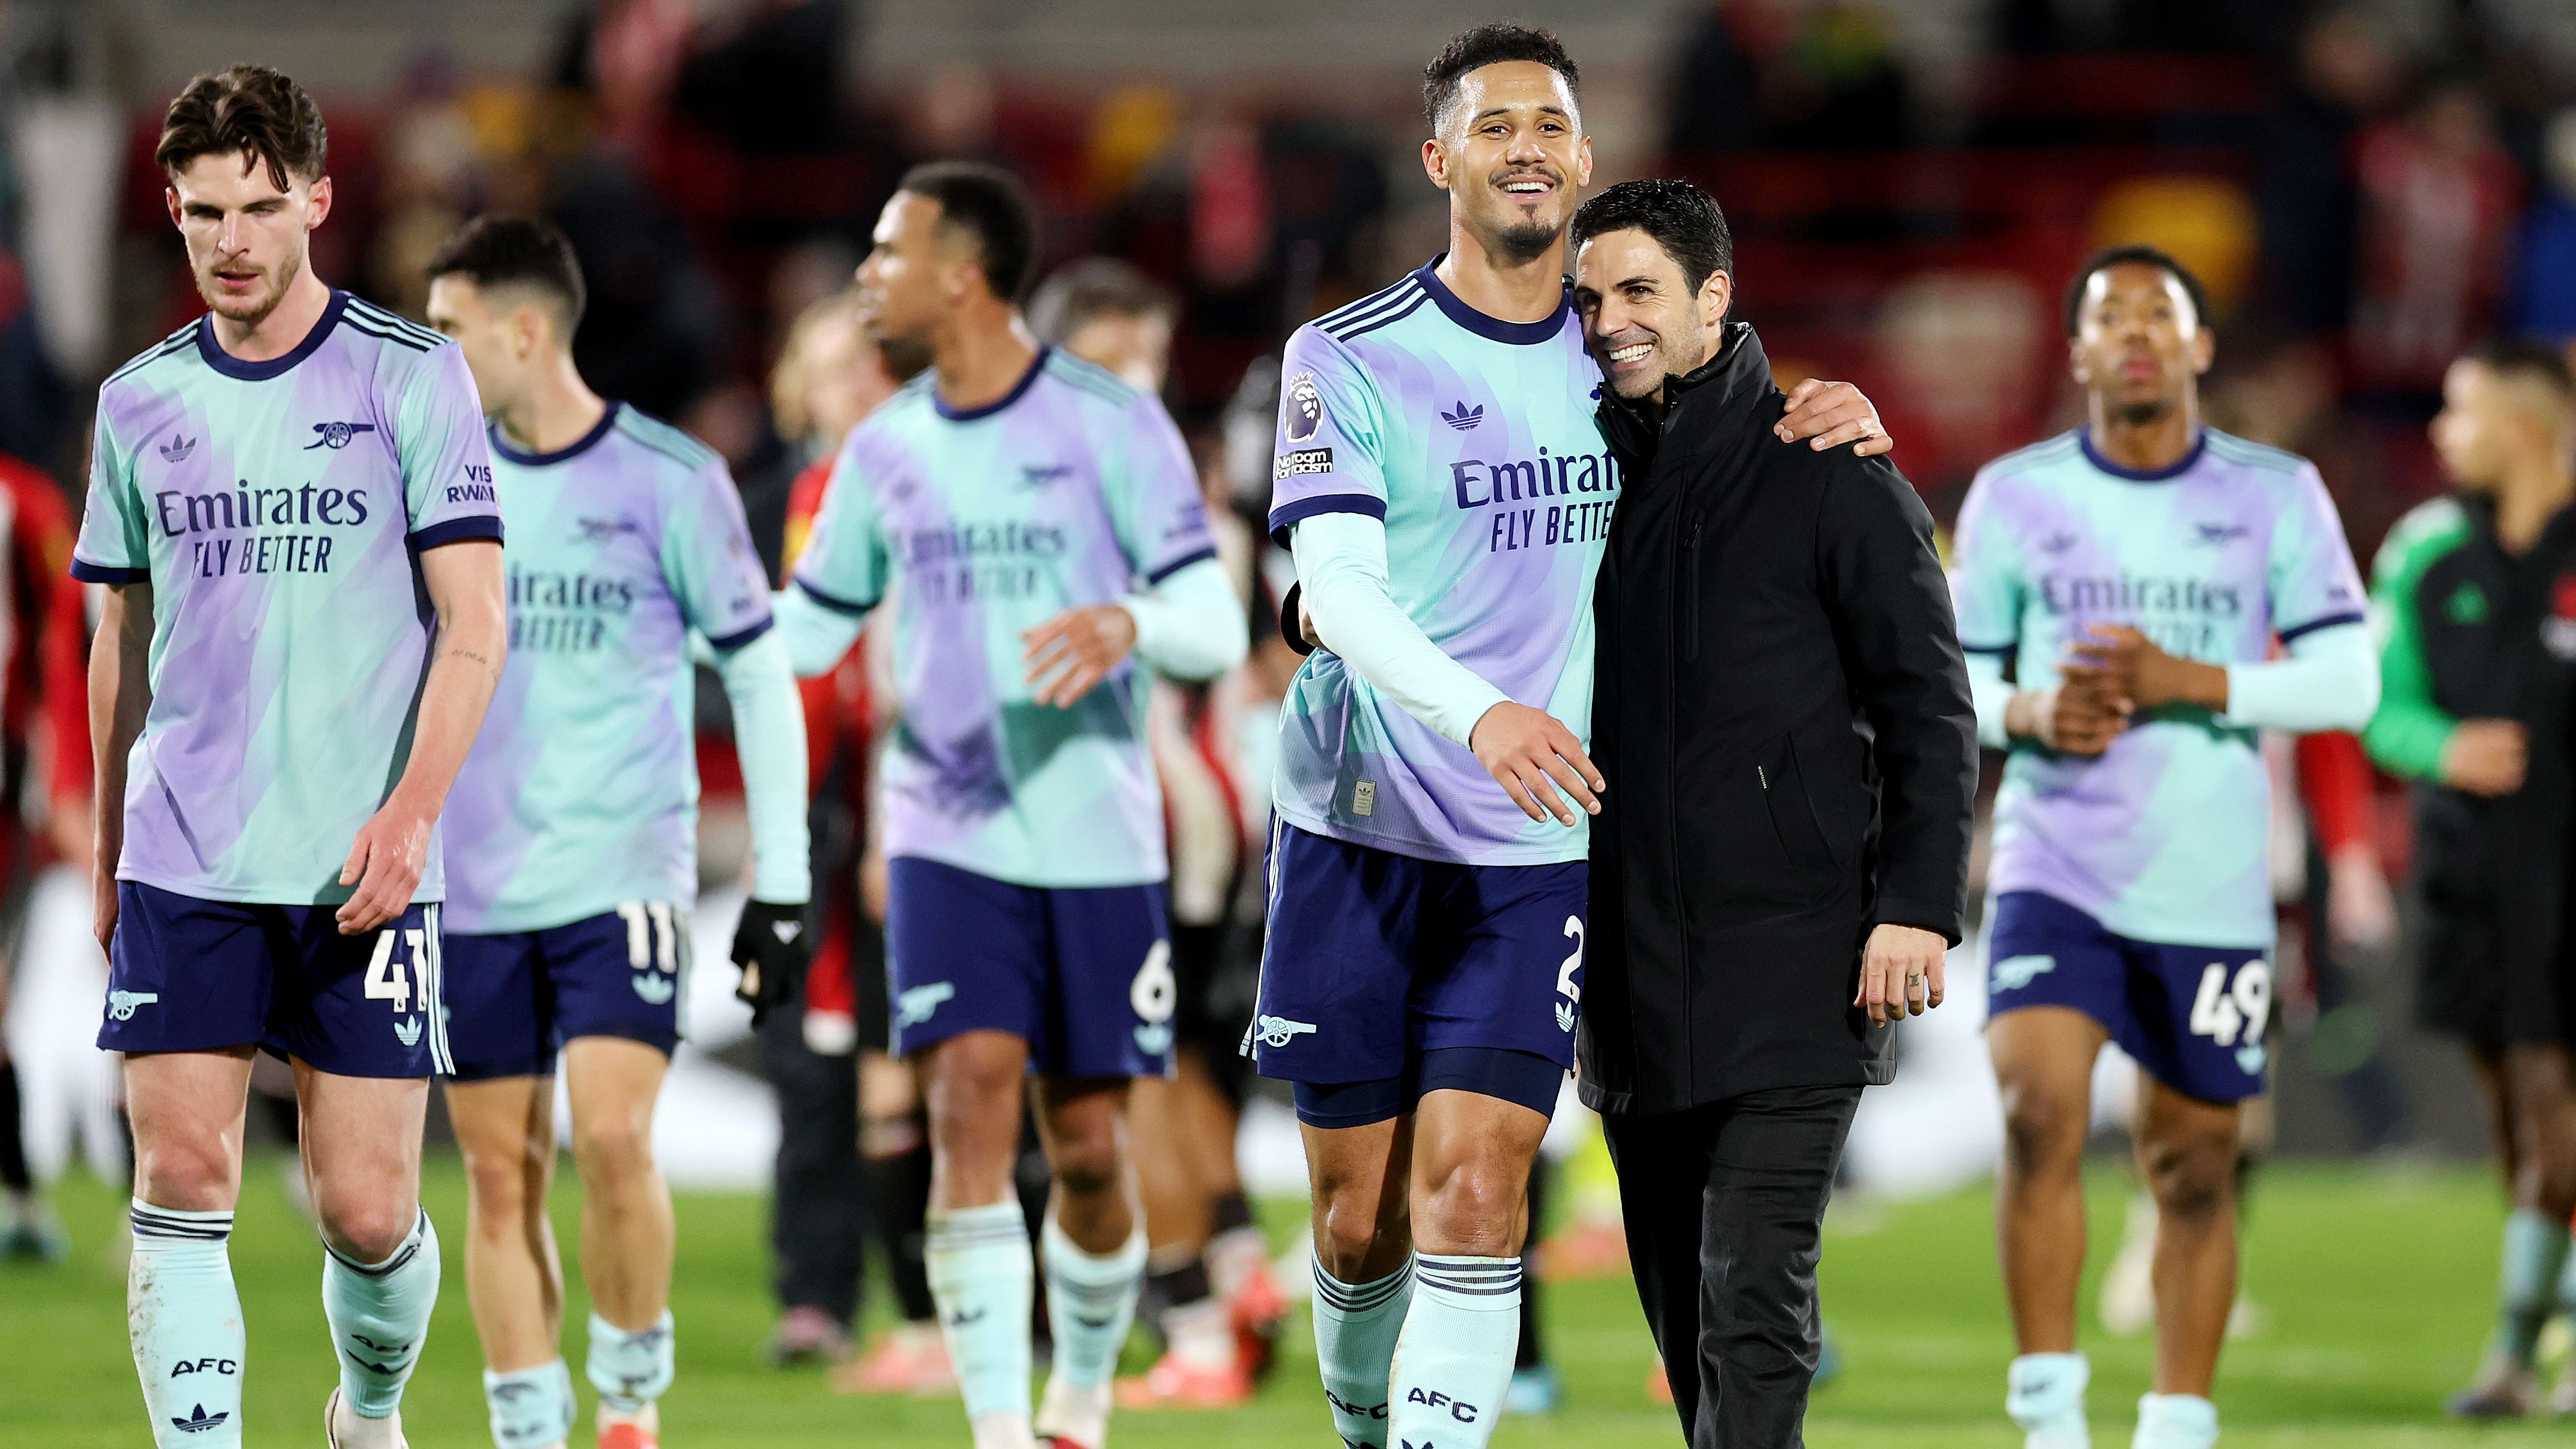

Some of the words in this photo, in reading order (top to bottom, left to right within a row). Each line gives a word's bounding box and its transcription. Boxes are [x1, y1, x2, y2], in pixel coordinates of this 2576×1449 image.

[464, 464, 491, 482] VIS
[1277, 457, 1291, 469] No
[1291, 451, 1326, 465] room
[1291, 461, 1333, 476] racism
[1449, 446, 1615, 509] Emirat
[155, 479, 368, 537] Emirates
[1490, 508, 1535, 552] FLY
[1545, 500, 1614, 546] BETTE
[192, 541, 232, 579] FLY
[239, 535, 332, 575] BETTER
[510, 560, 634, 615] irates
[616, 899, 678, 974] 11
[1556, 914, 1584, 1004] 2
[363, 929, 428, 1013] 41
[1129, 938, 1177, 1023] 6
[2189, 959, 2271, 1046] 49
[171, 1358, 237, 1378] AFC
[1408, 1387, 1478, 1424] AFC
